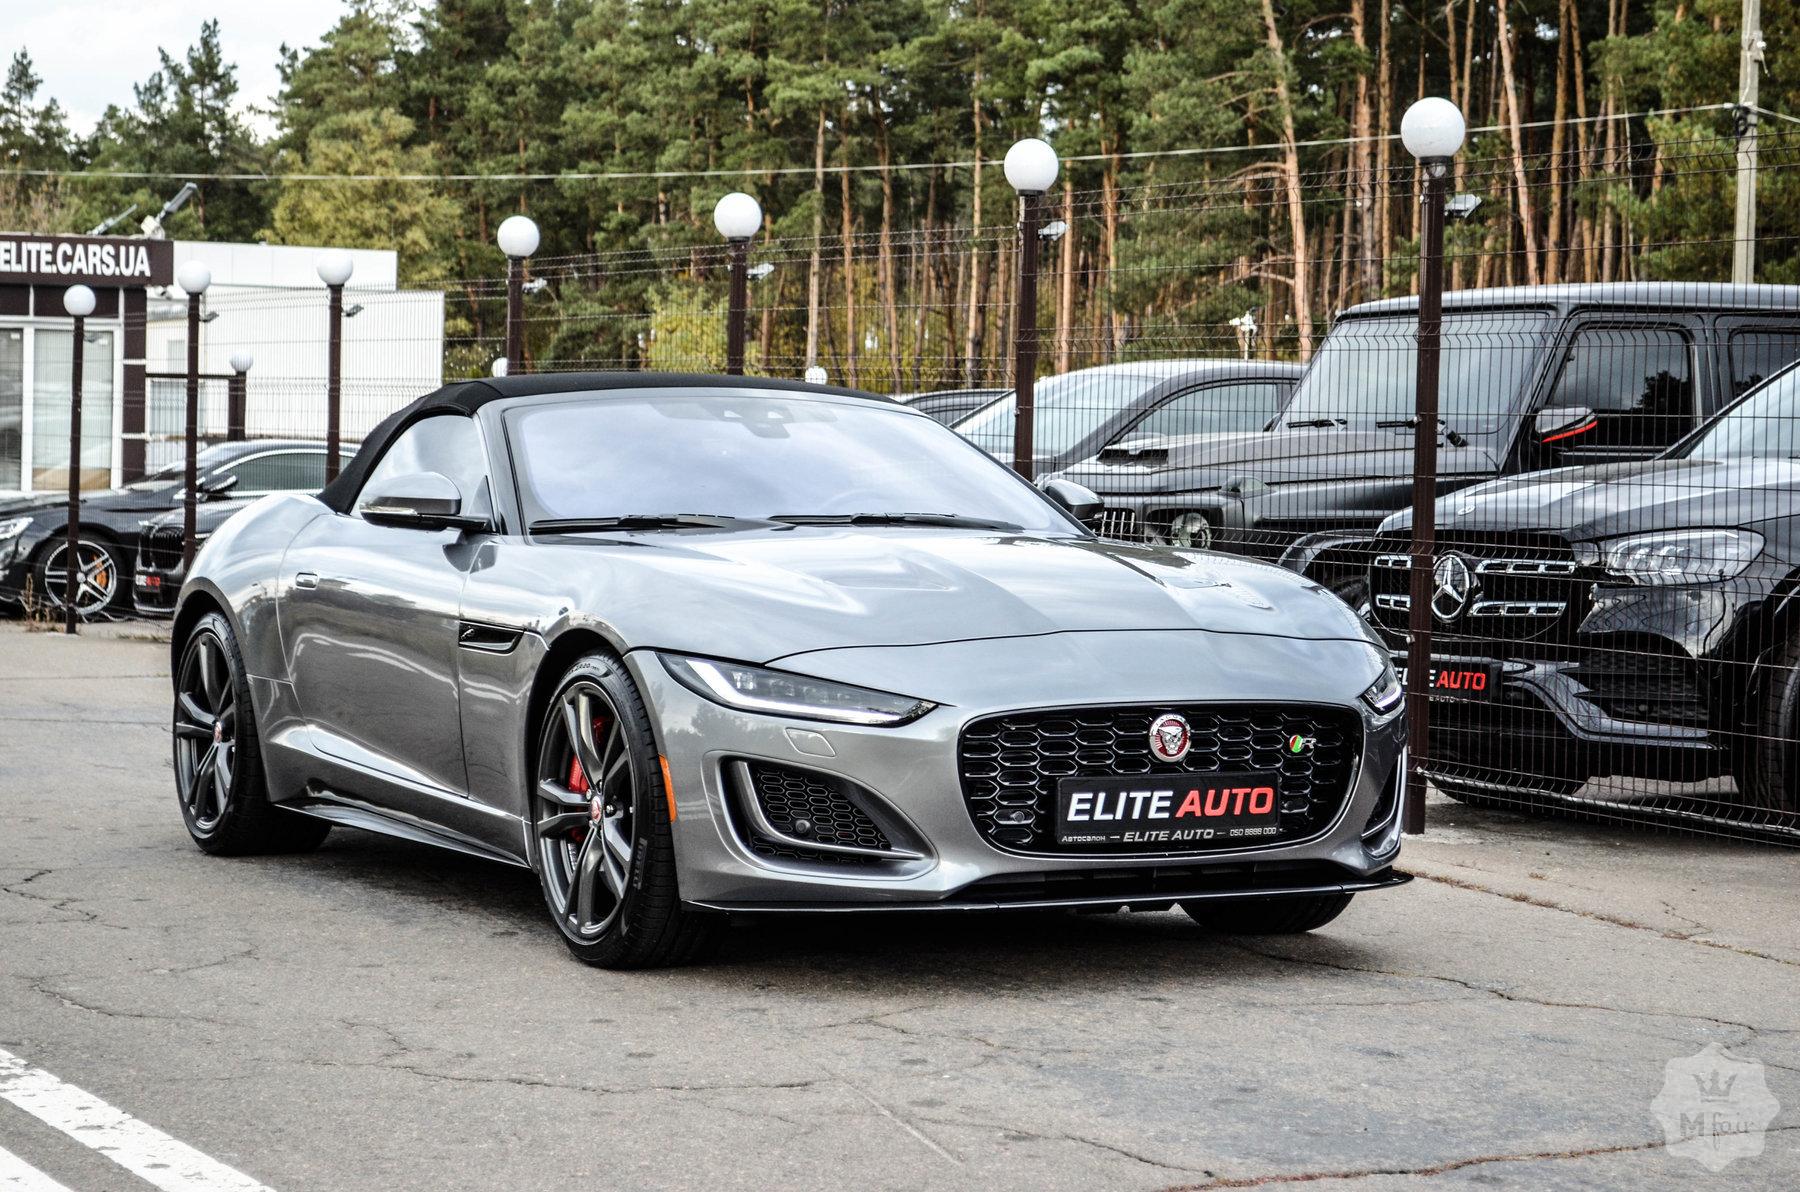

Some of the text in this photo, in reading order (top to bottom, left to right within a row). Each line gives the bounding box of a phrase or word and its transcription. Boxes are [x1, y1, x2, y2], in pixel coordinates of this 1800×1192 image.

[0, 241, 151, 277] ELITE.CARS.UA
[1437, 671, 1486, 690] AUTO
[1067, 787, 1274, 821] ELITE AUTO
[1123, 831, 1170, 842] ELITE
[1171, 829, 1214, 840] AUTO
